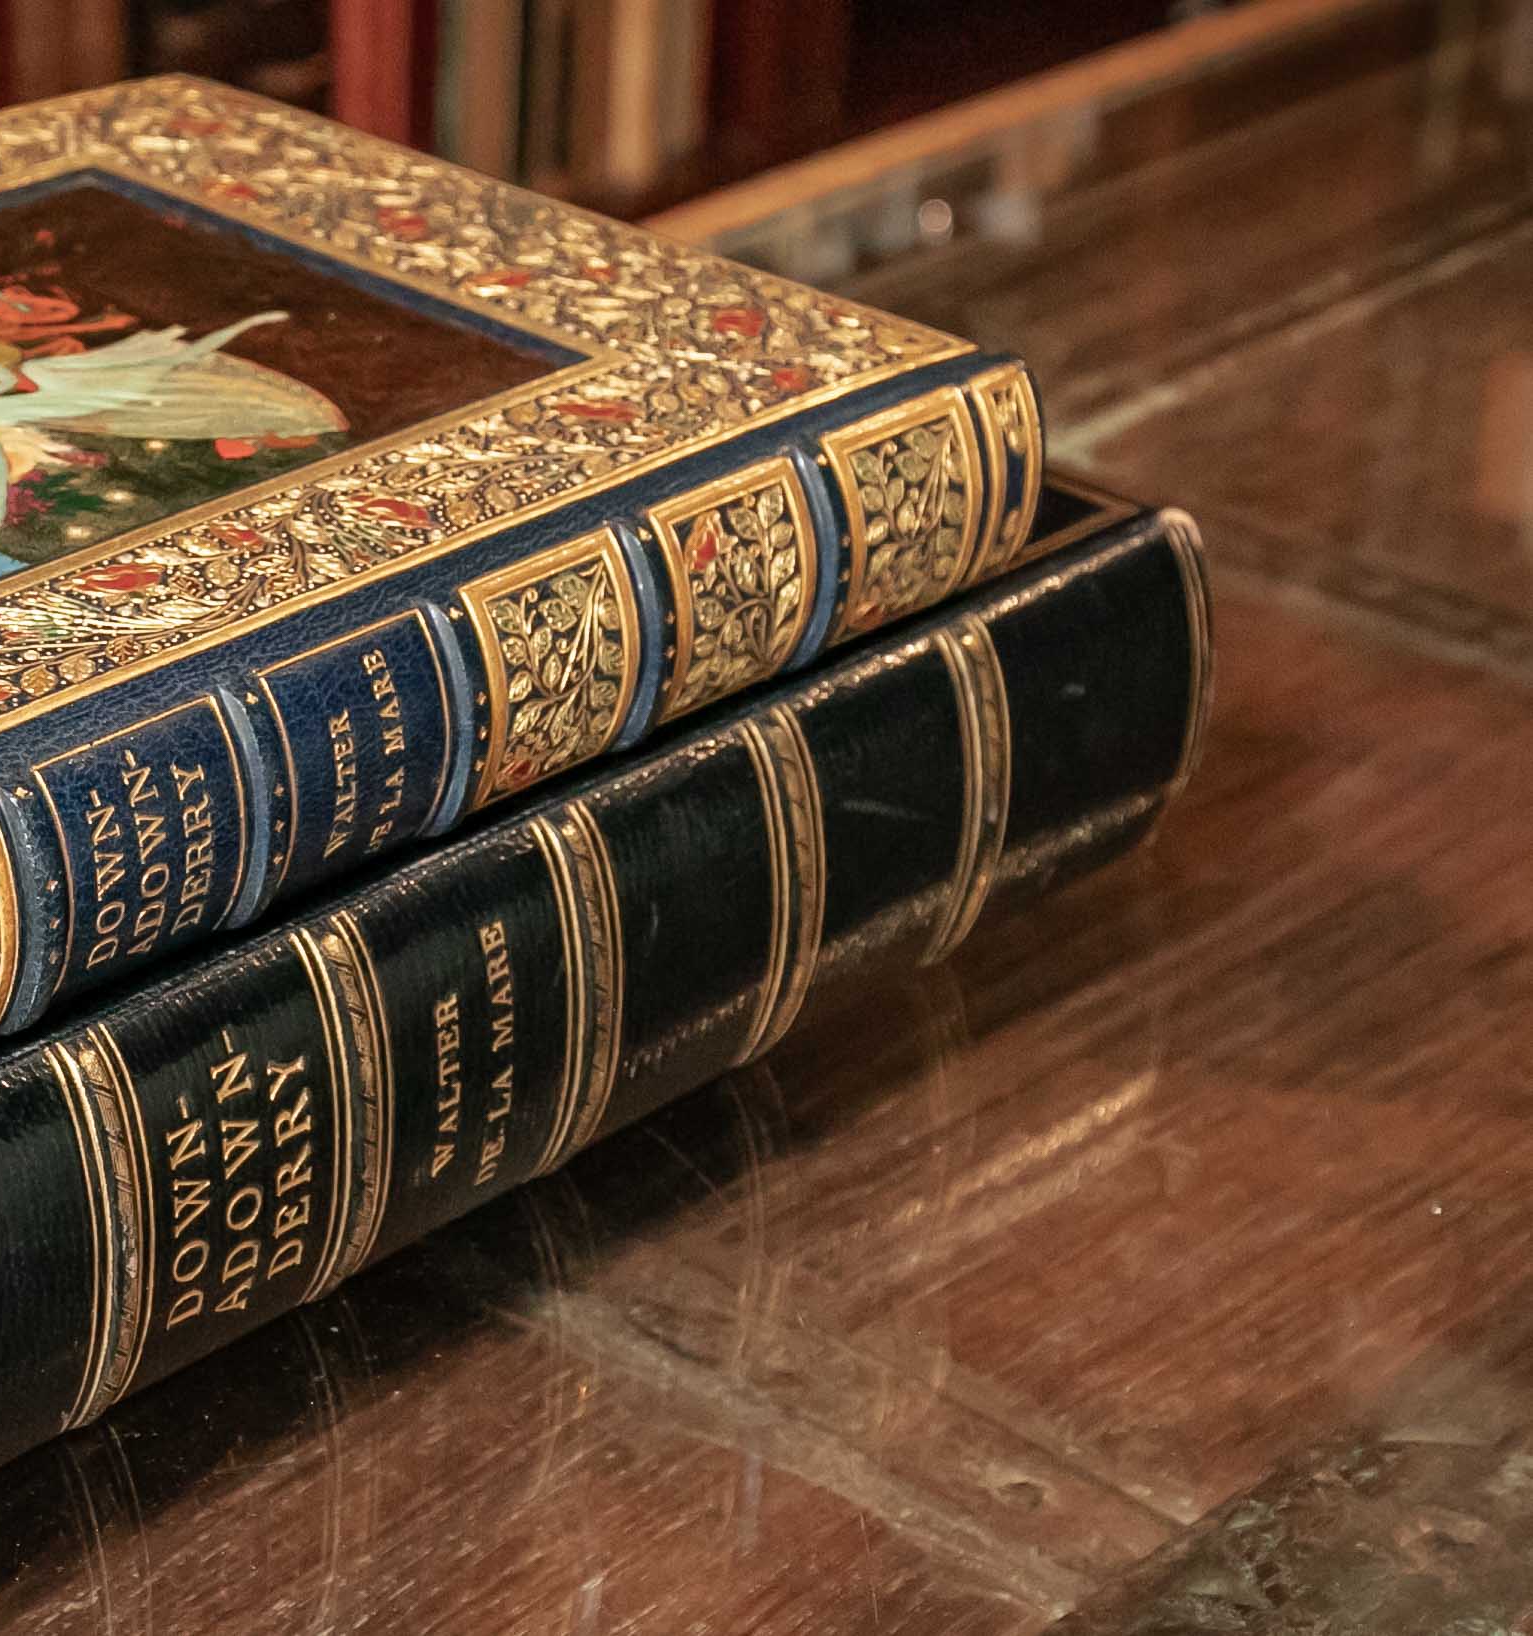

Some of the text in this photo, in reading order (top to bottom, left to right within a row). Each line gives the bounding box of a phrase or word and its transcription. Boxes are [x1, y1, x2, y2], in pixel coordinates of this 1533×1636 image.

[322, 707, 358, 859] WALTER
[361, 648, 406, 854] E LA MARE
[86, 788, 127, 971] DOWN-
[121, 749, 171, 957] ADOWN-
[170, 763, 216, 936] DERRY
[478, 918, 515, 1053] MARE
[210, 1028, 263, 1313] ADOWN-
[267, 1055, 314, 1281] DERRY
[430, 992, 463, 1179] WALTER
[486, 1063, 515, 1123] LA
[166, 1095, 211, 1330] DOWN-
